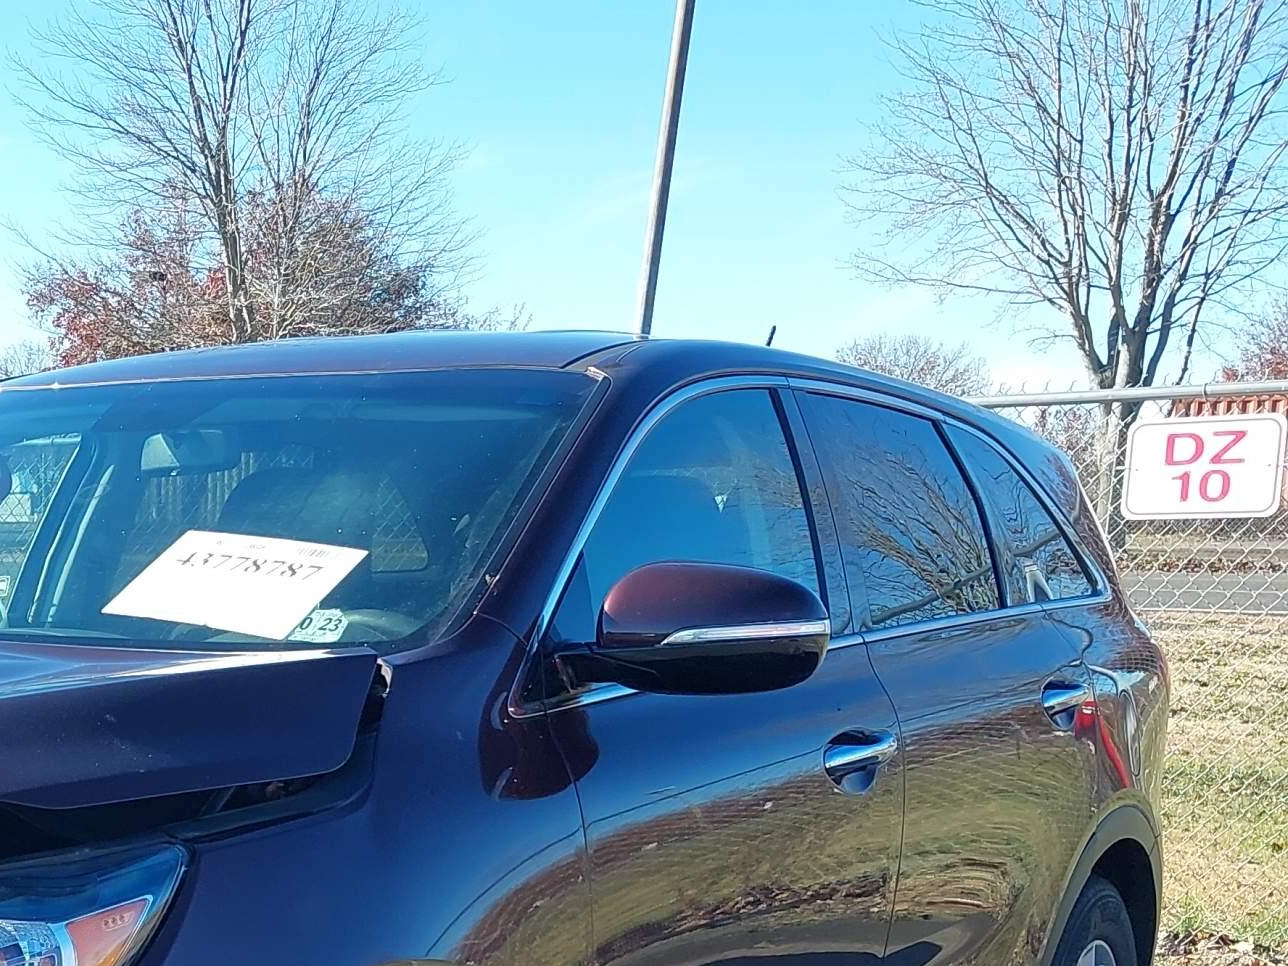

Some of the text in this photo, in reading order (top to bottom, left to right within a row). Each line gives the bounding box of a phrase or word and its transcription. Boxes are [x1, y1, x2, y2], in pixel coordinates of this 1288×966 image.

[1164, 430, 1248, 466] DZ
[1172, 469, 1231, 502] 10
[176, 551, 324, 581] 43778787
[318, 617, 343, 632] 23
